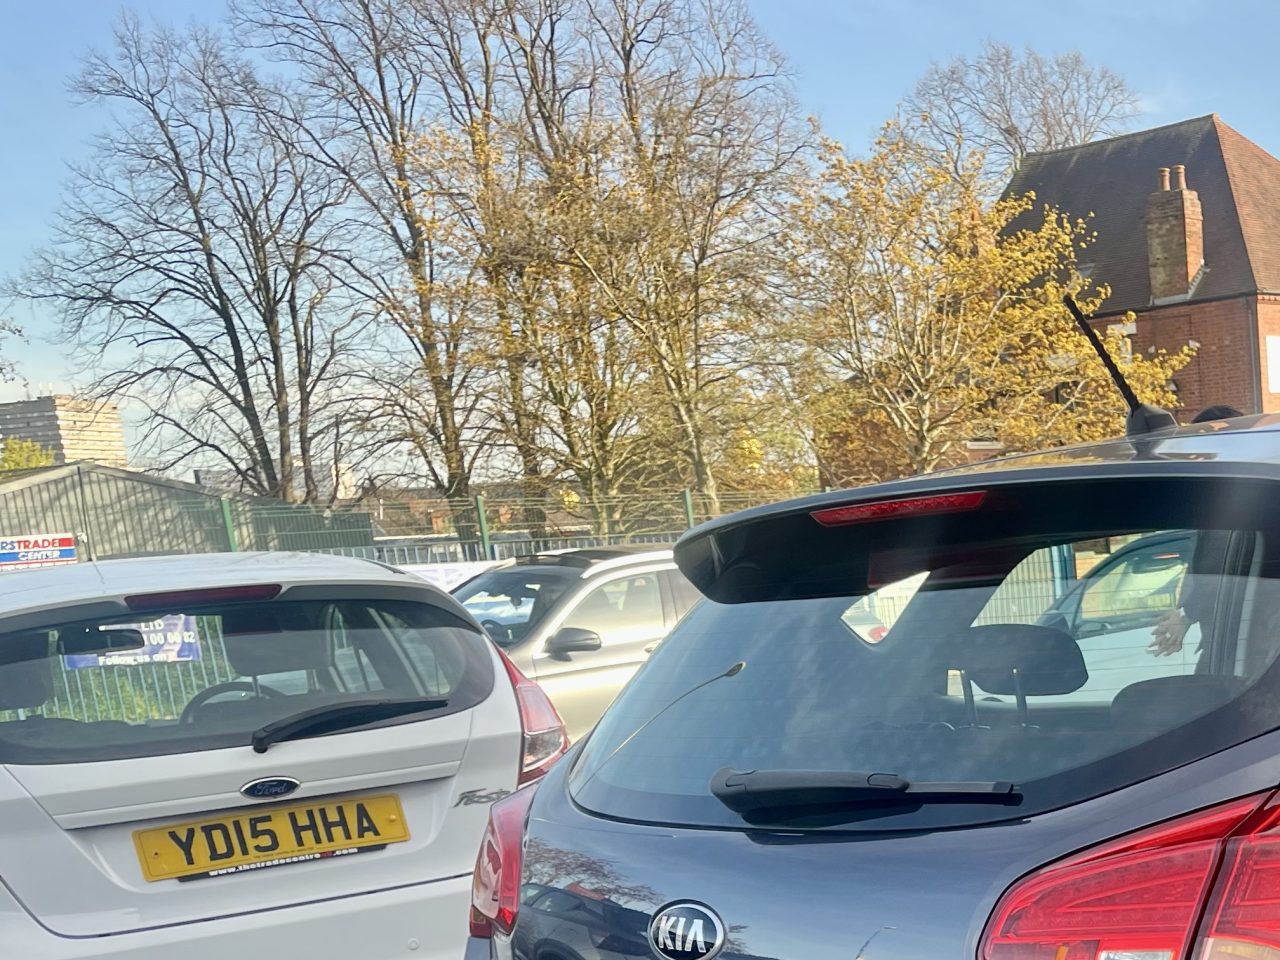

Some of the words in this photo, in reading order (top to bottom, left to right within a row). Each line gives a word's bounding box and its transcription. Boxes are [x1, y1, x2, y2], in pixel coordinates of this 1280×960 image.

[256, 782, 288, 795] Ford
[168, 815, 280, 866] YD15
[288, 803, 381, 847] HHA
[658, 915, 707, 953] KIA
